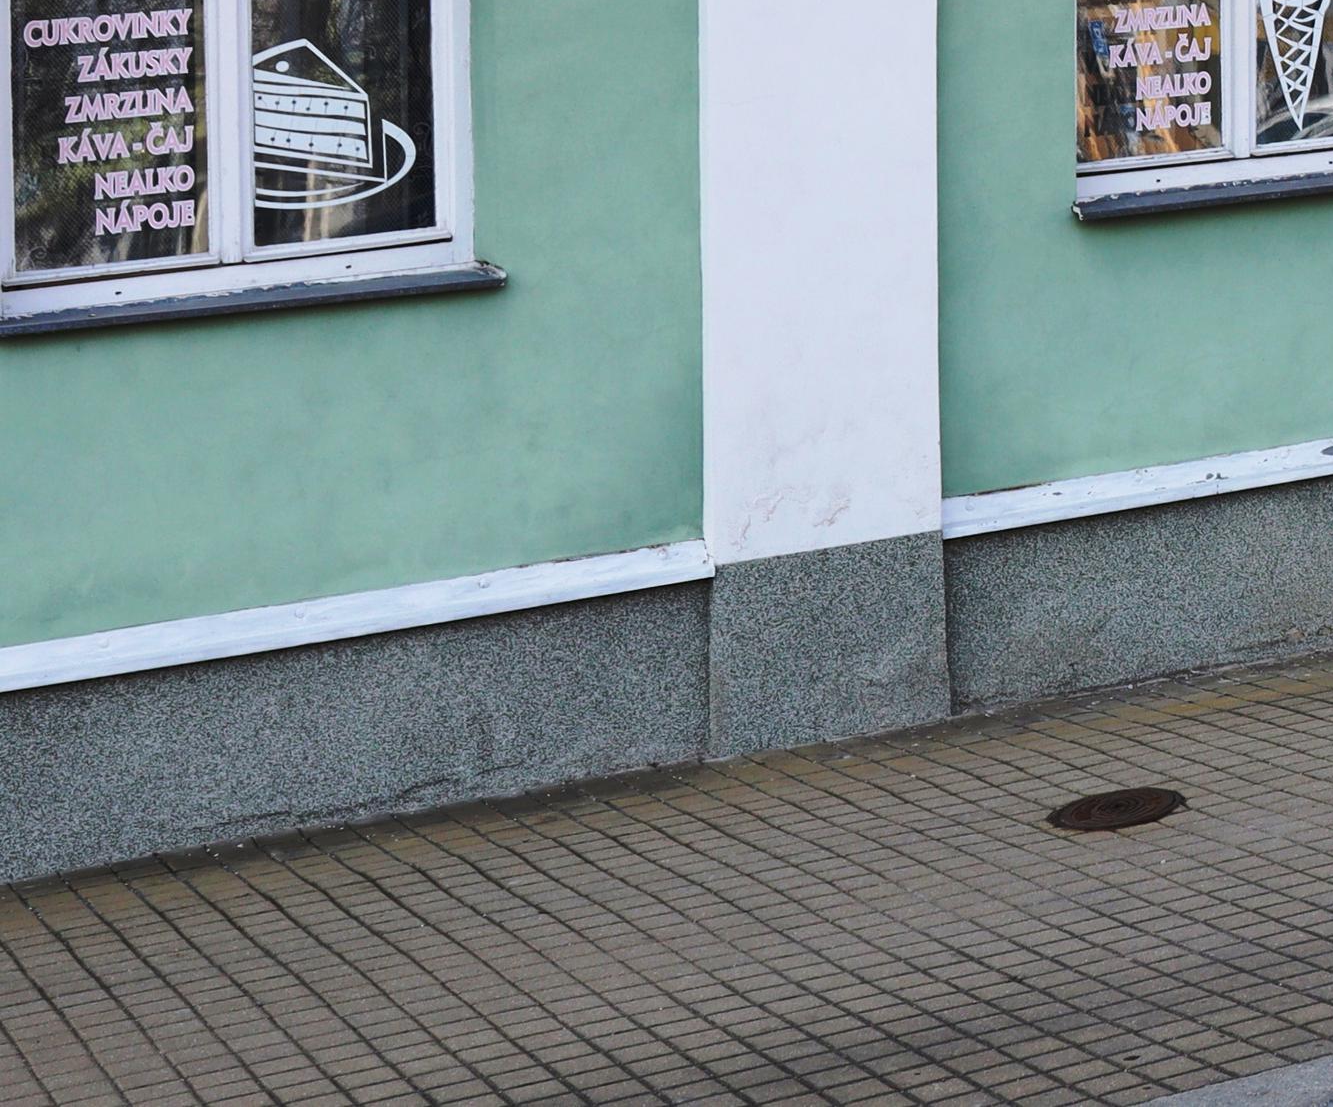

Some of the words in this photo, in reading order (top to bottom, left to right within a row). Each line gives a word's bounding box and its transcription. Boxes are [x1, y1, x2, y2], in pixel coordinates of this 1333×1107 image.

[23, 8, 193, 47] CUKROVINKY
[1114, 2, 1211, 32] ZMRZLINA
[77, 47, 193, 82] ZÁKUSKY
[1109, 38, 1163, 68] KÁVA
[1175, 32, 1211, 61] ČAJ
[1136, 71, 1211, 100] NEALKO
[64, 86, 194, 123] ZMRZLINA
[1135, 101, 1211, 131] NÁPOJE
[58, 127, 130, 163] KÁVA
[144, 123, 194, 154] ČAJ
[94, 165, 195, 199] NEALKO
[95, 199, 195, 235] NÁPOJE
